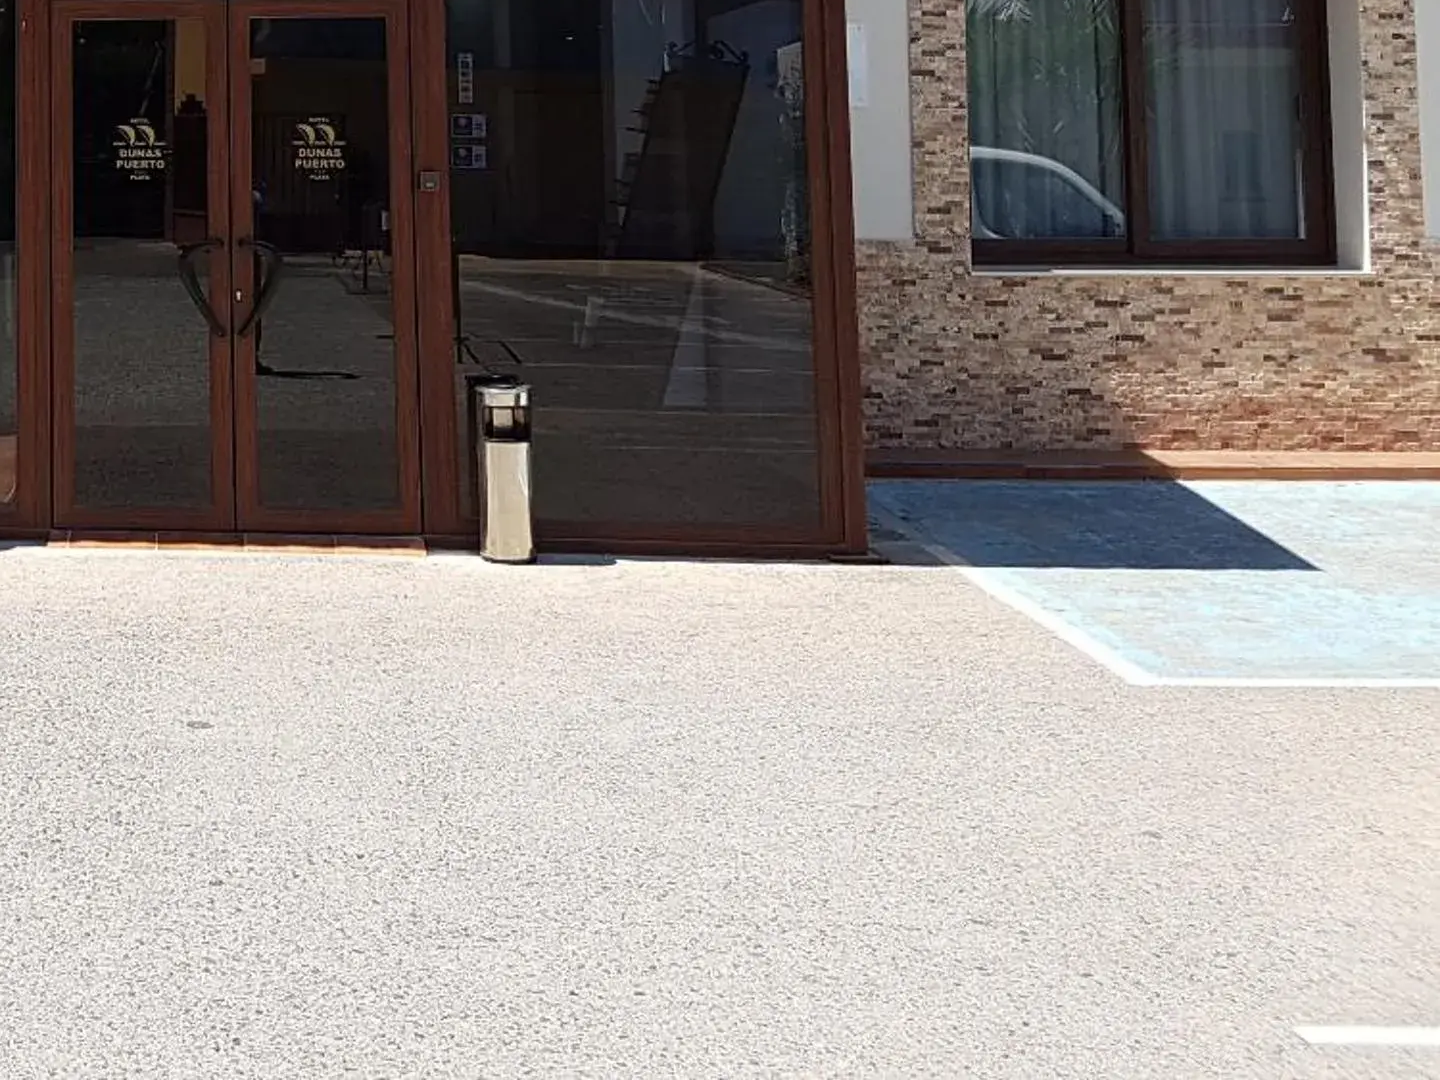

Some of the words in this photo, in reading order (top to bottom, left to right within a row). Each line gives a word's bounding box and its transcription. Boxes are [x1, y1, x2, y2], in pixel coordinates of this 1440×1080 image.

[119, 148, 162, 158] DUNAS
[298, 148, 342, 158] DUNAS
[116, 159, 165, 169] PUERTO
[295, 159, 345, 169] PUERTO
